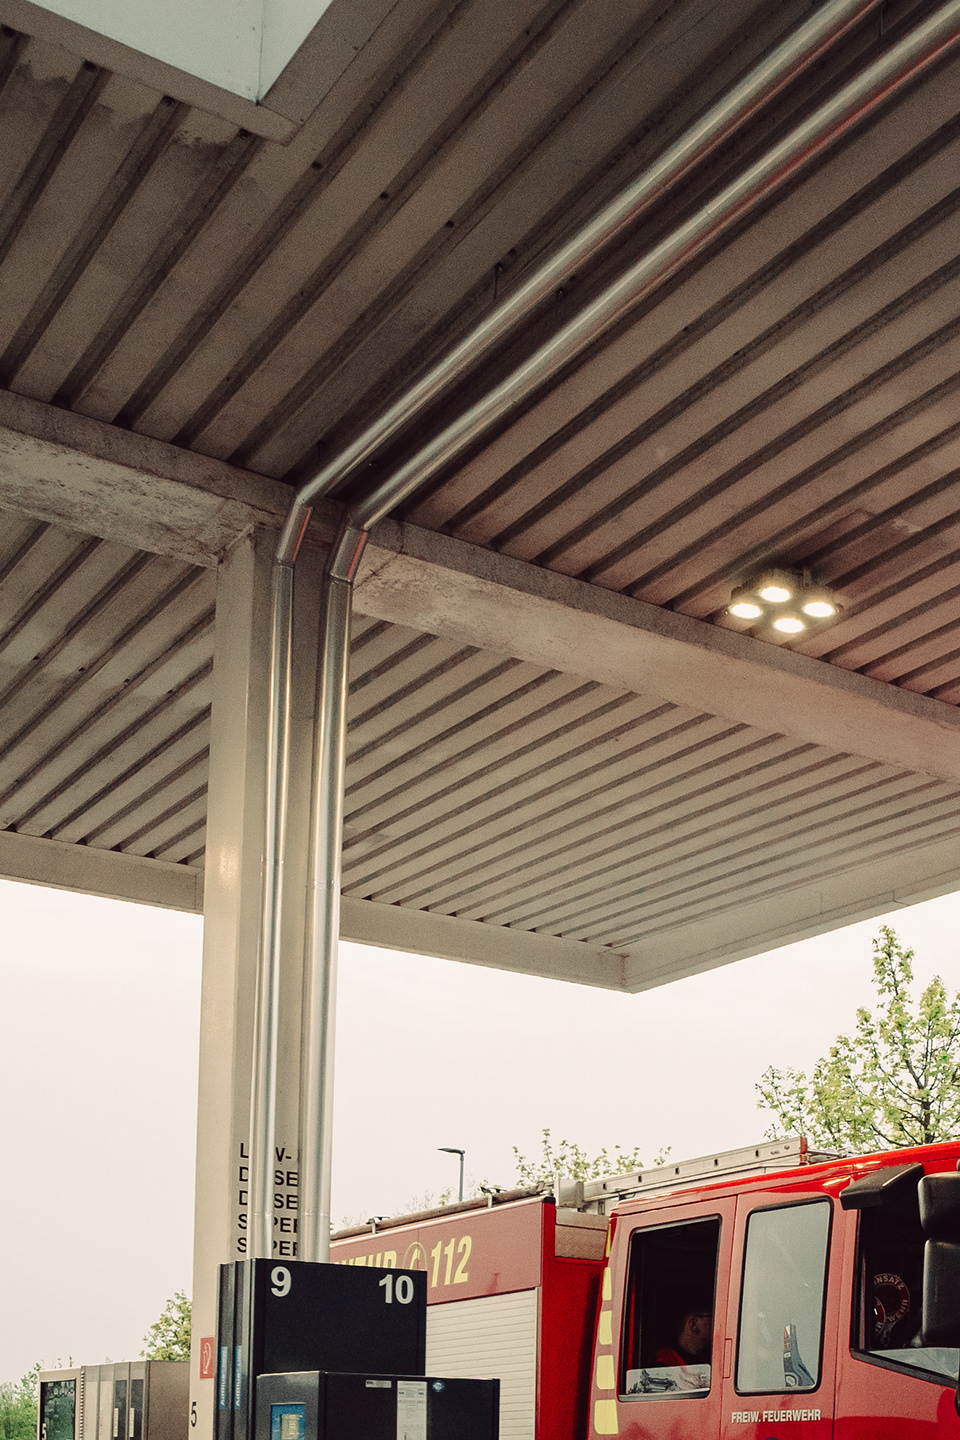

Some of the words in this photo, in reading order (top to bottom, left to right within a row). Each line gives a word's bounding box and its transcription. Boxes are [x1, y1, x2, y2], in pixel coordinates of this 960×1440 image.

[431, 1235, 472, 1288] 112
[270, 1266, 292, 1297] 9
[379, 1274, 414, 1304] 10
[874, 1275, 905, 1291] INSATZ
[190, 1401, 197, 1427] 5
[731, 1411, 761, 1423] FREIW.
[762, 1408, 821, 1422] FEUERWEHR
